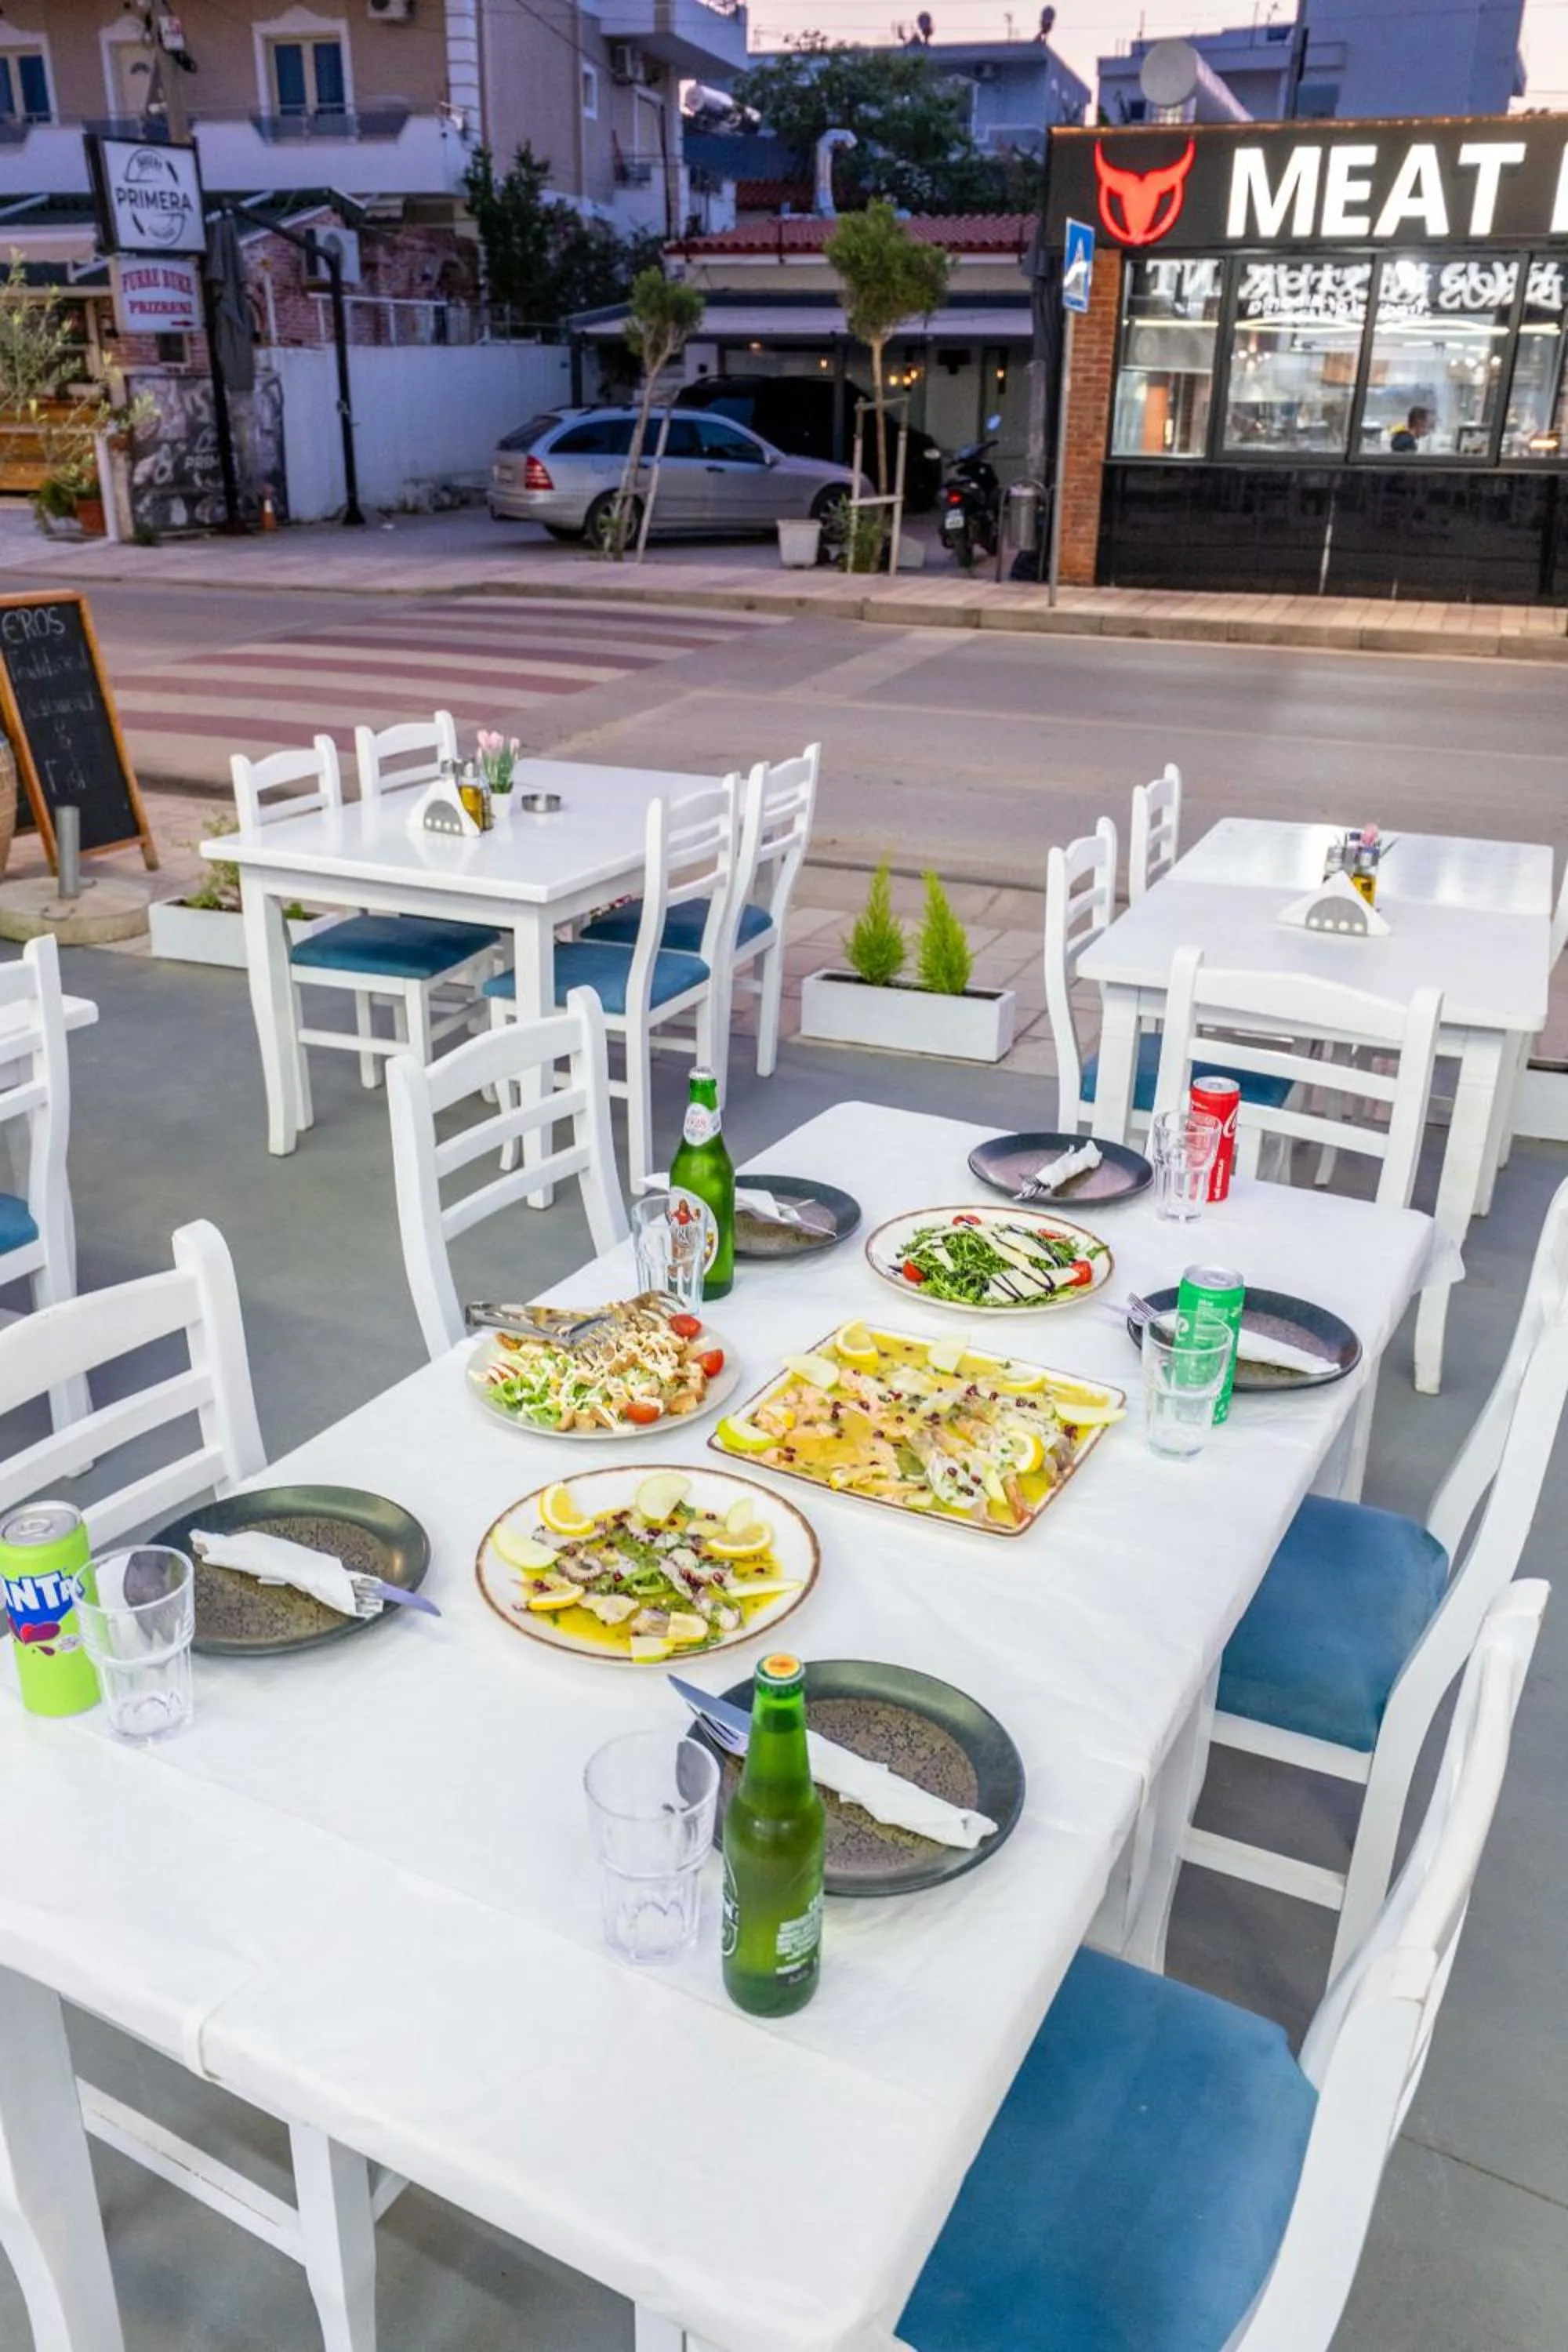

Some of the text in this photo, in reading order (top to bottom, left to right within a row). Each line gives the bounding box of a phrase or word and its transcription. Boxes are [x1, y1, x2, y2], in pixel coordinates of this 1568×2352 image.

[115, 187, 194, 212] PRIMERA
[1226, 142, 1526, 238] MEAT
[2, 607, 66, 644] EROS
